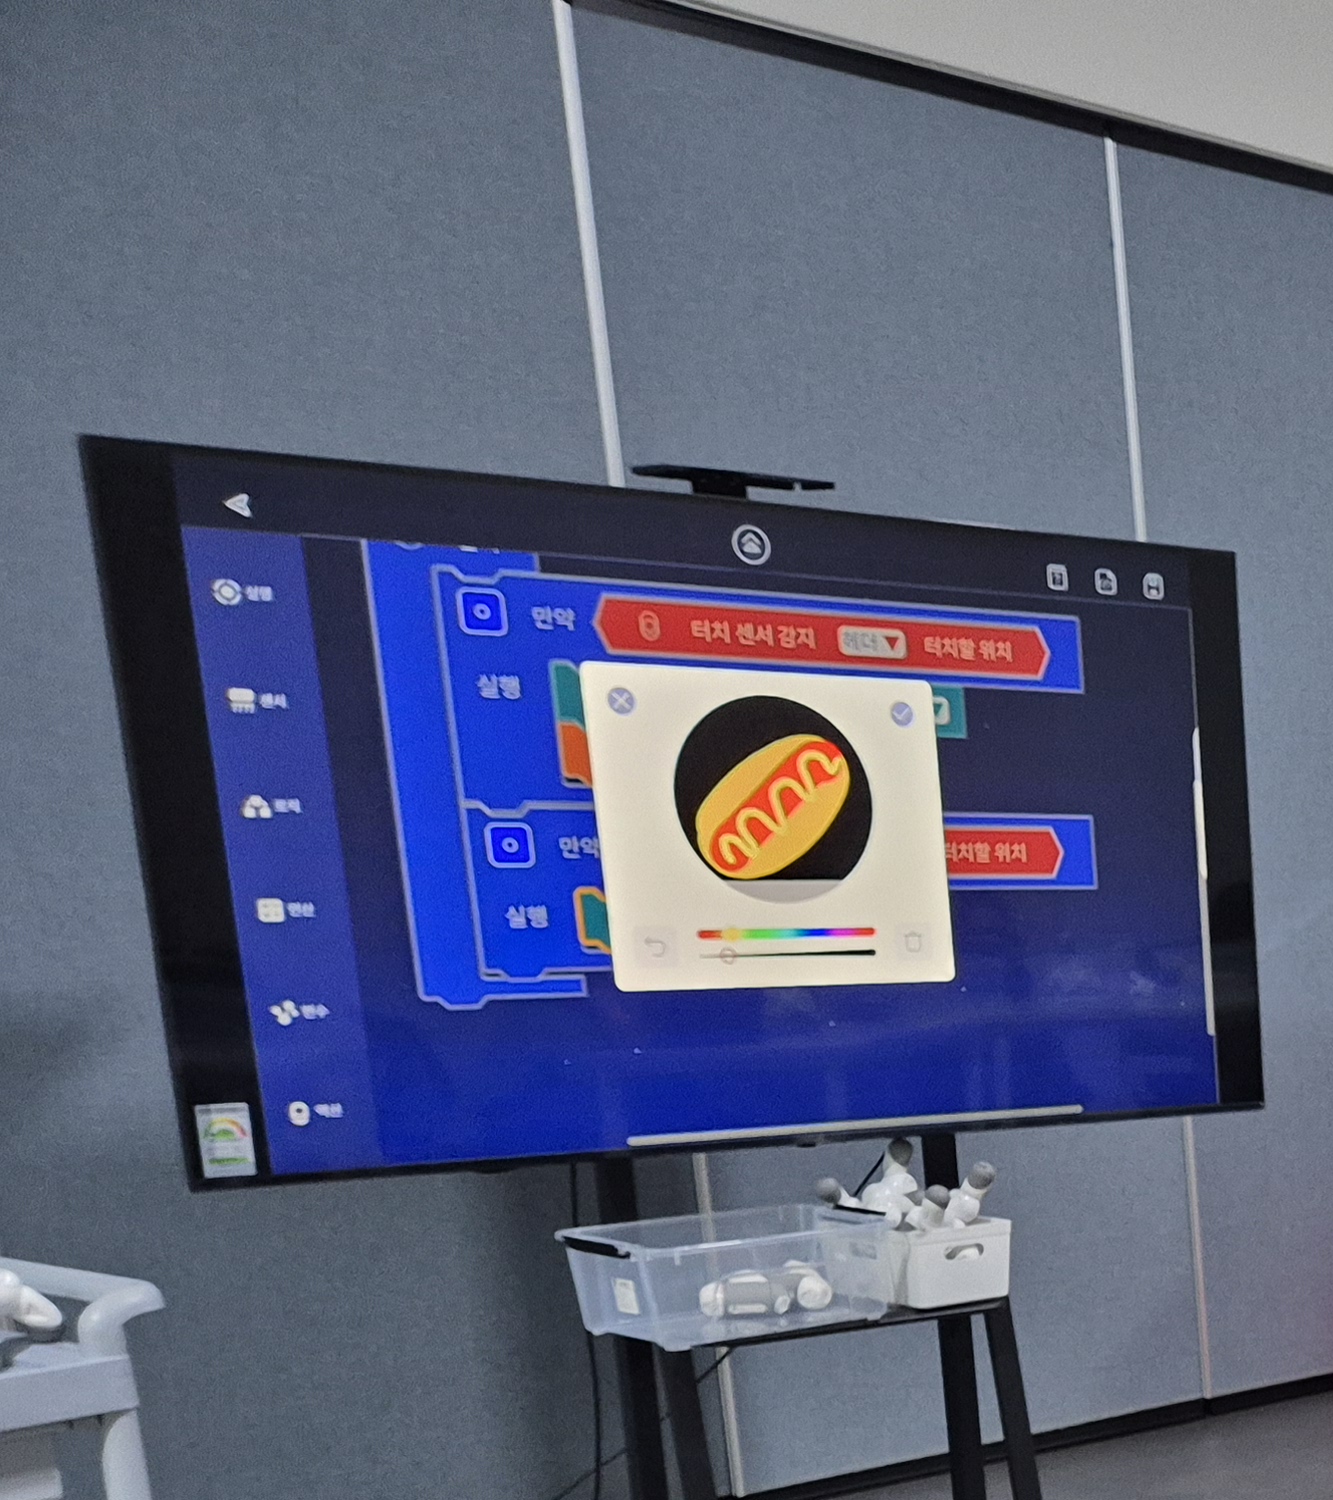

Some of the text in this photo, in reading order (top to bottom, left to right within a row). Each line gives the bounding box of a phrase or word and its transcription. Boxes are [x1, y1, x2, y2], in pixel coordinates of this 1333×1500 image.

[530, 605, 577, 632] 만약
[689, 618, 732, 645] 터치
[734, 622, 775, 647] 센서
[777, 624, 819, 651] 감지
[922, 635, 977, 662] 터치할
[978, 638, 1014, 663] 위치
[475, 673, 523, 701] 실행
[993, 841, 1029, 864] 위치
[504, 903, 550, 930] 실행
